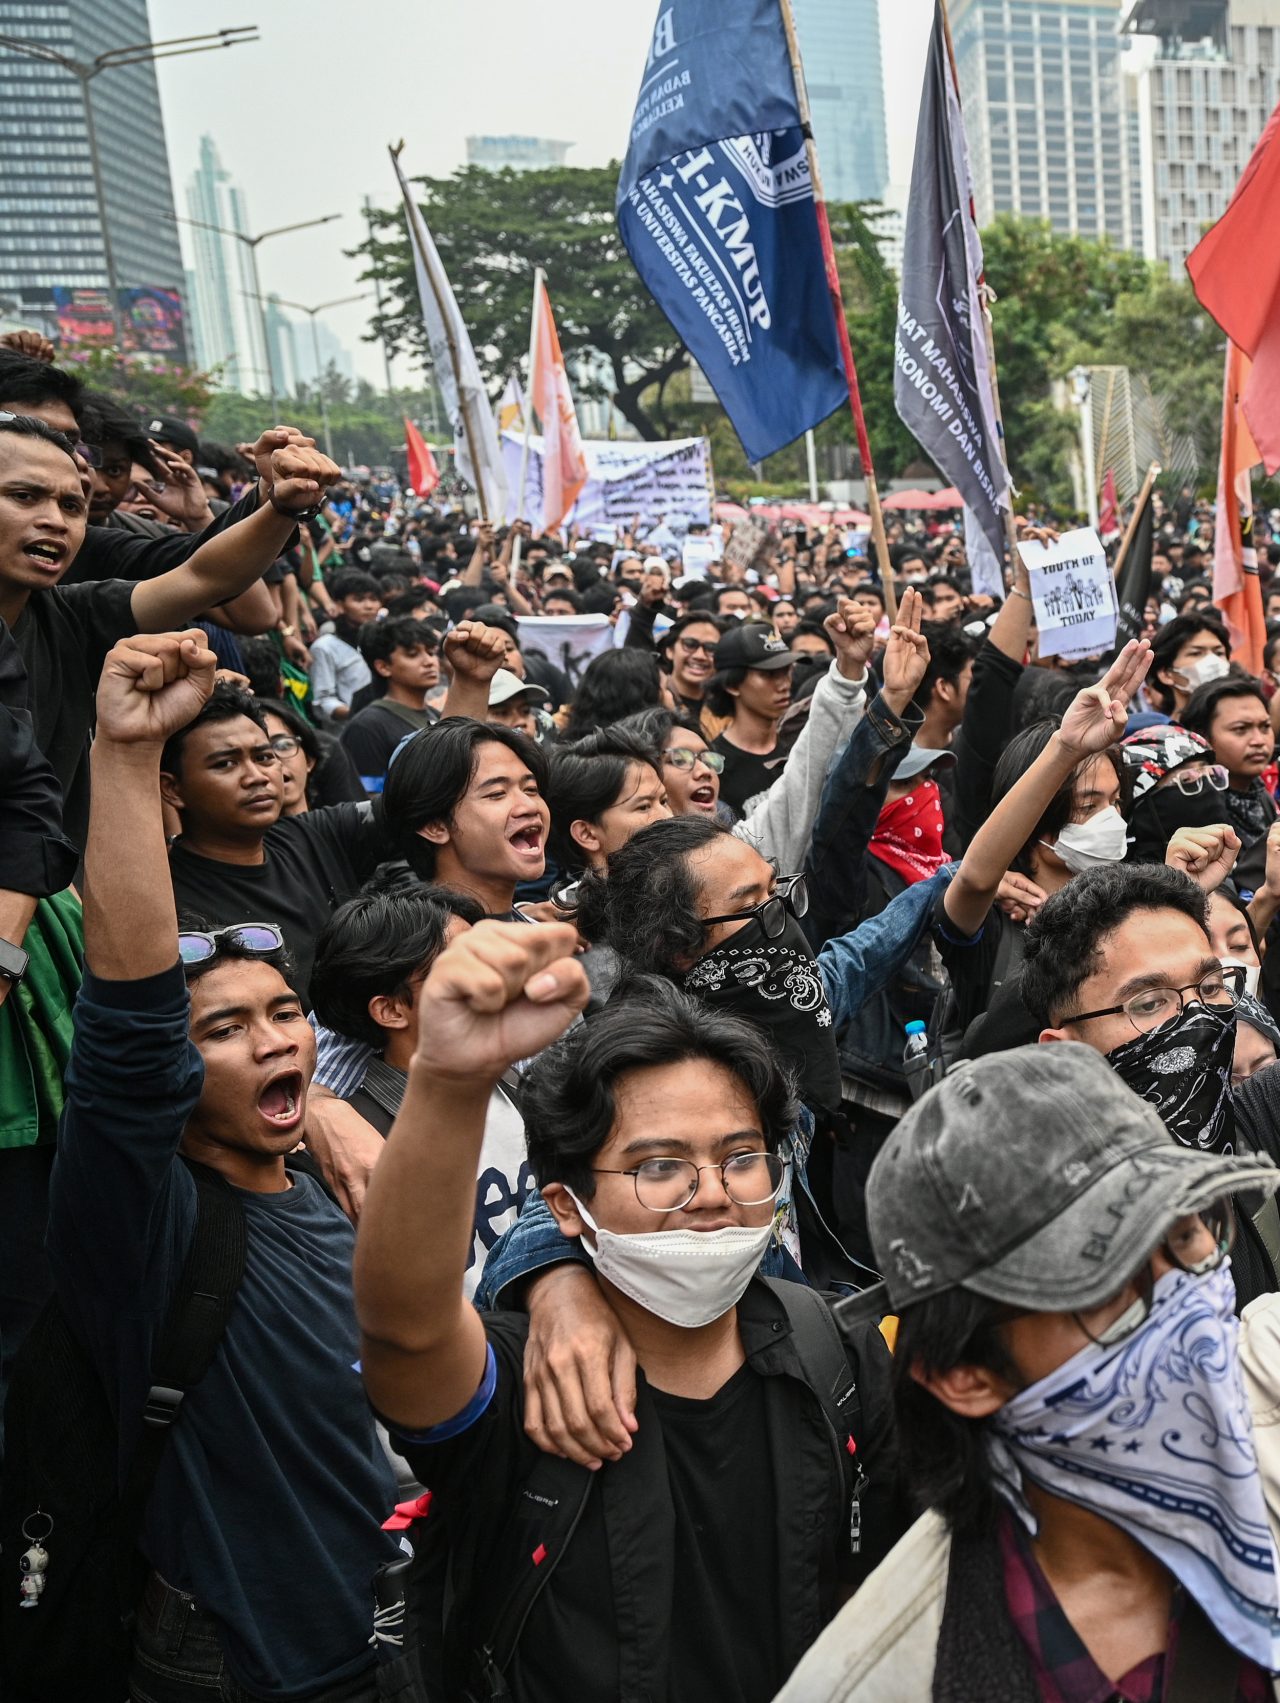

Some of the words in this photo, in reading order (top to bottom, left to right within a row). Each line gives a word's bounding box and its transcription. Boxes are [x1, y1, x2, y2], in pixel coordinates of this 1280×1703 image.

[636, 202, 699, 289] UNIVERSITAS
[691, 287, 741, 366] PANCASILA
[683, 242, 732, 309] FAKULTAS
[725, 308, 751, 363] HUKUM
[898, 294, 927, 341] NAT
[920, 338, 982, 448] MAHASISWA
[948, 418, 976, 461] DAN
[1042, 559, 1079, 575] YOUTH
[1060, 610, 1096, 628] TODAY
